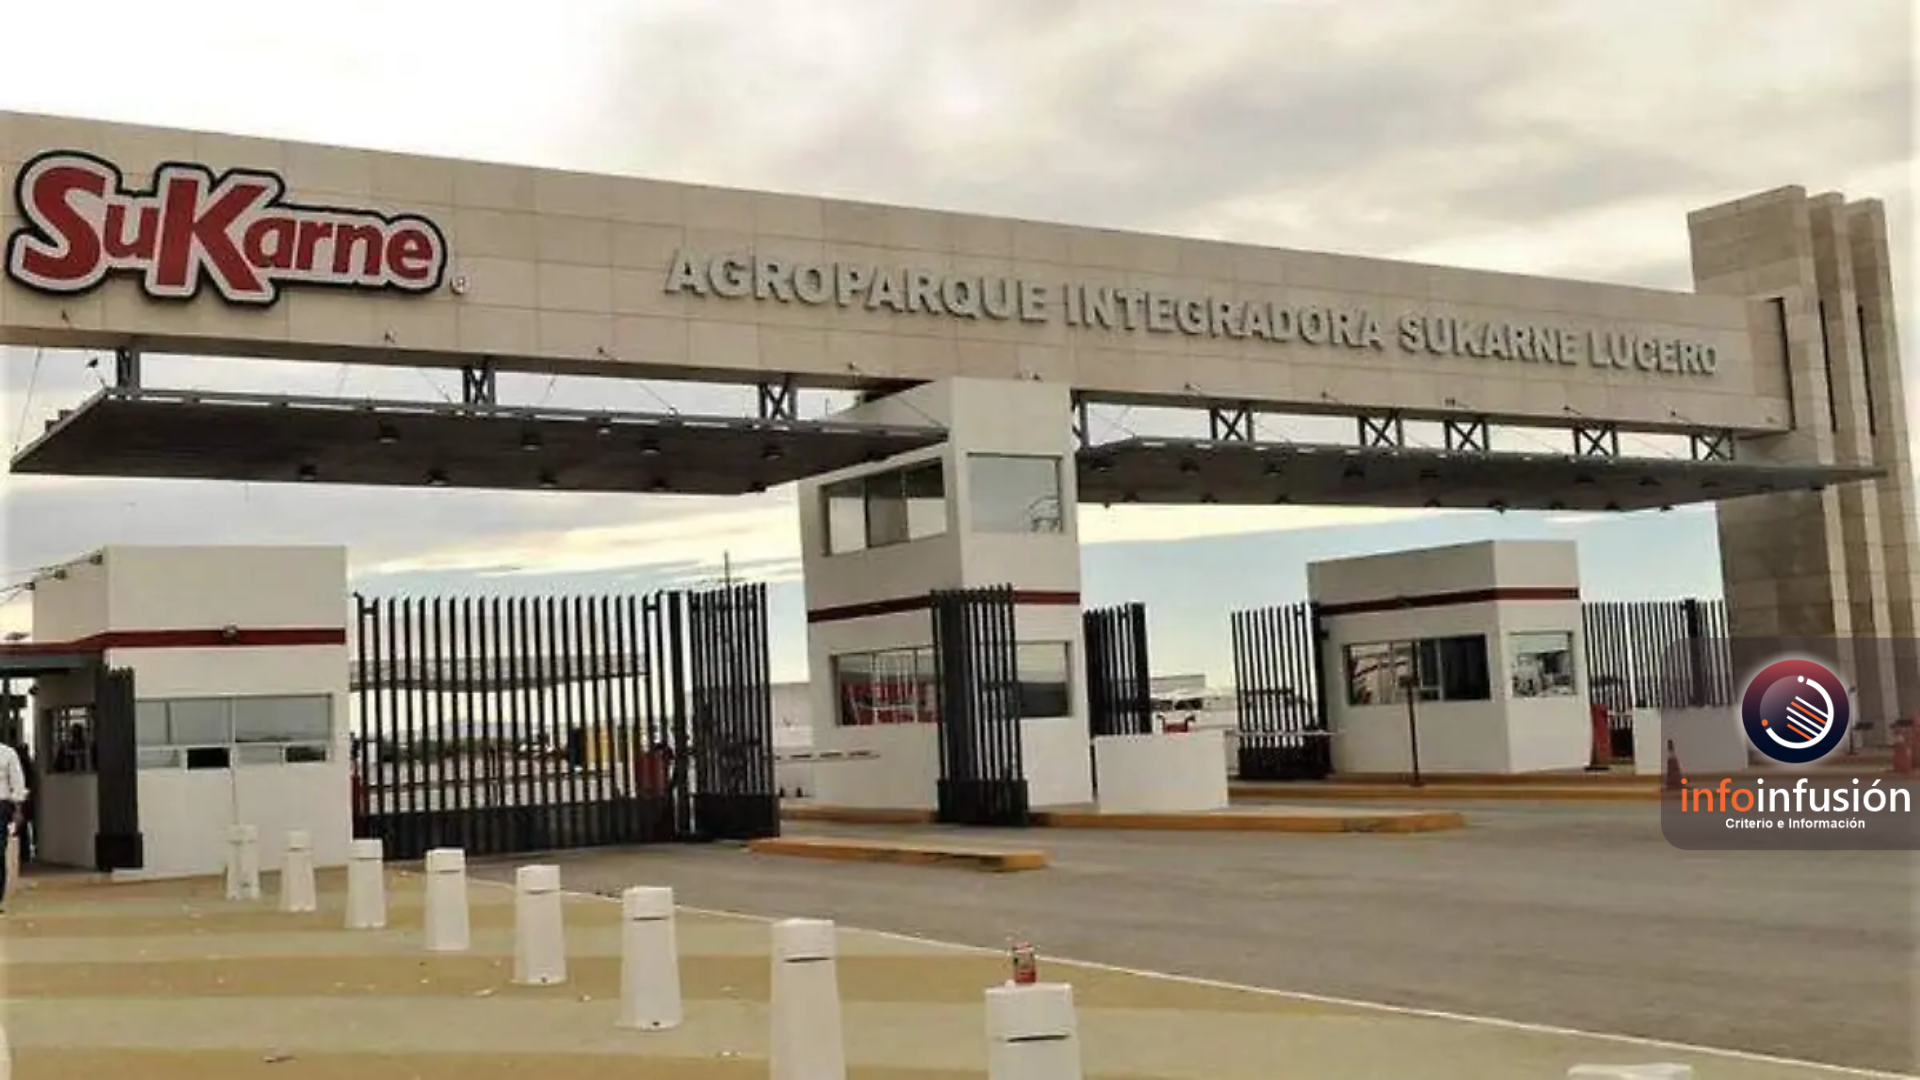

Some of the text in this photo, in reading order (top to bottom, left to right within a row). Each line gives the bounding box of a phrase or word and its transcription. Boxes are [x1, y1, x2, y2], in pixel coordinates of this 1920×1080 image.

[20, 162, 436, 296] SuKarne
[664, 246, 1718, 377] AGROPARQUE INTEGRADORA SUKARNE LUCERO
